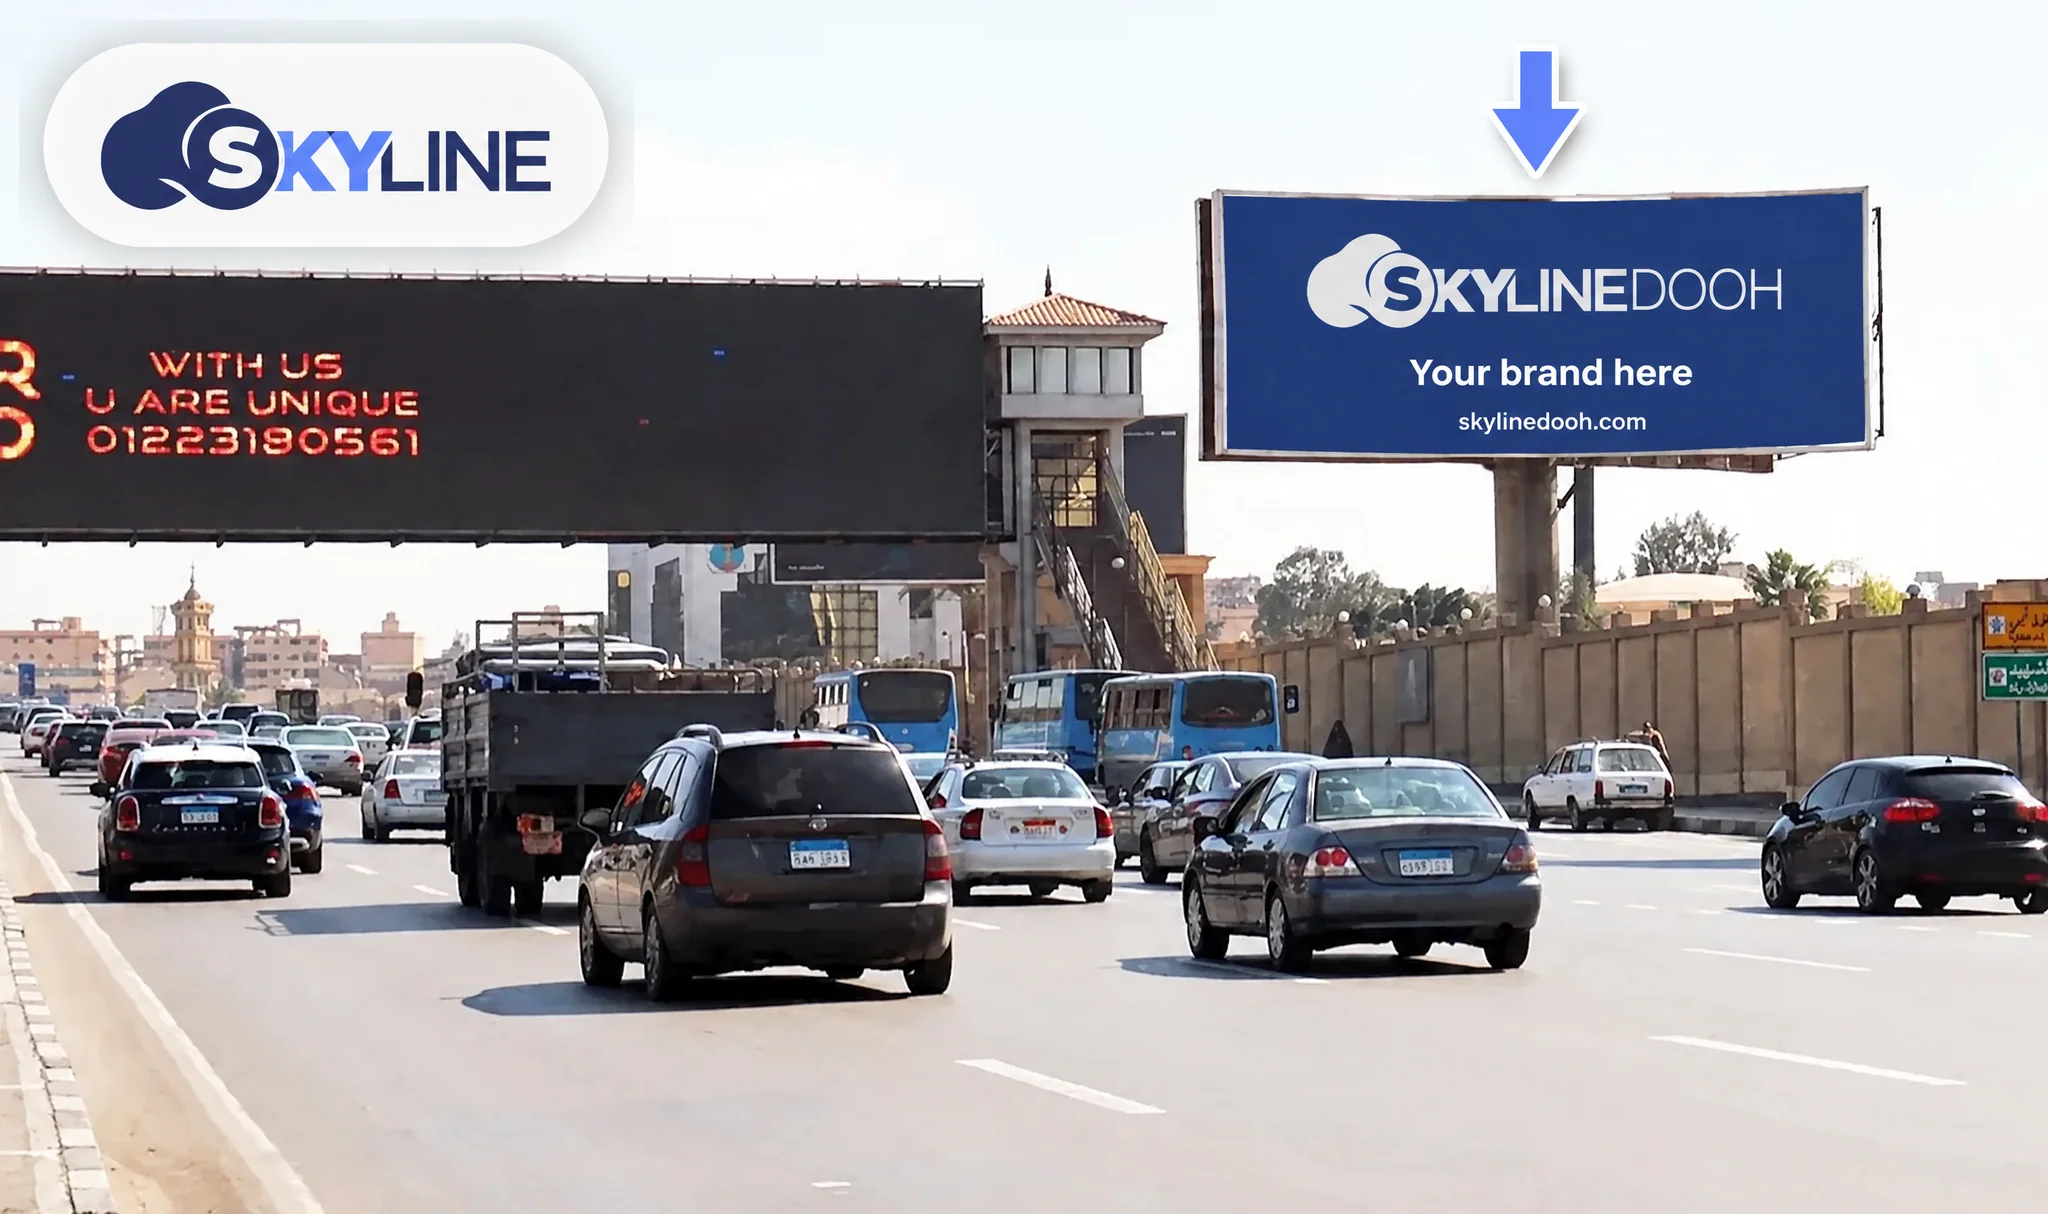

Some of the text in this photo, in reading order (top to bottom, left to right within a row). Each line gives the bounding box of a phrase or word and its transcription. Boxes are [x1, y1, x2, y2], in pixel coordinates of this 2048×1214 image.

[149, 351, 343, 380] WITH US
[1409, 357, 1693, 387] Your brand here
[85, 387, 419, 418] U ARE UNIQUE
[1458, 411, 1647, 435] skylinedooh.com
[87, 425, 419, 457] 01223190561
